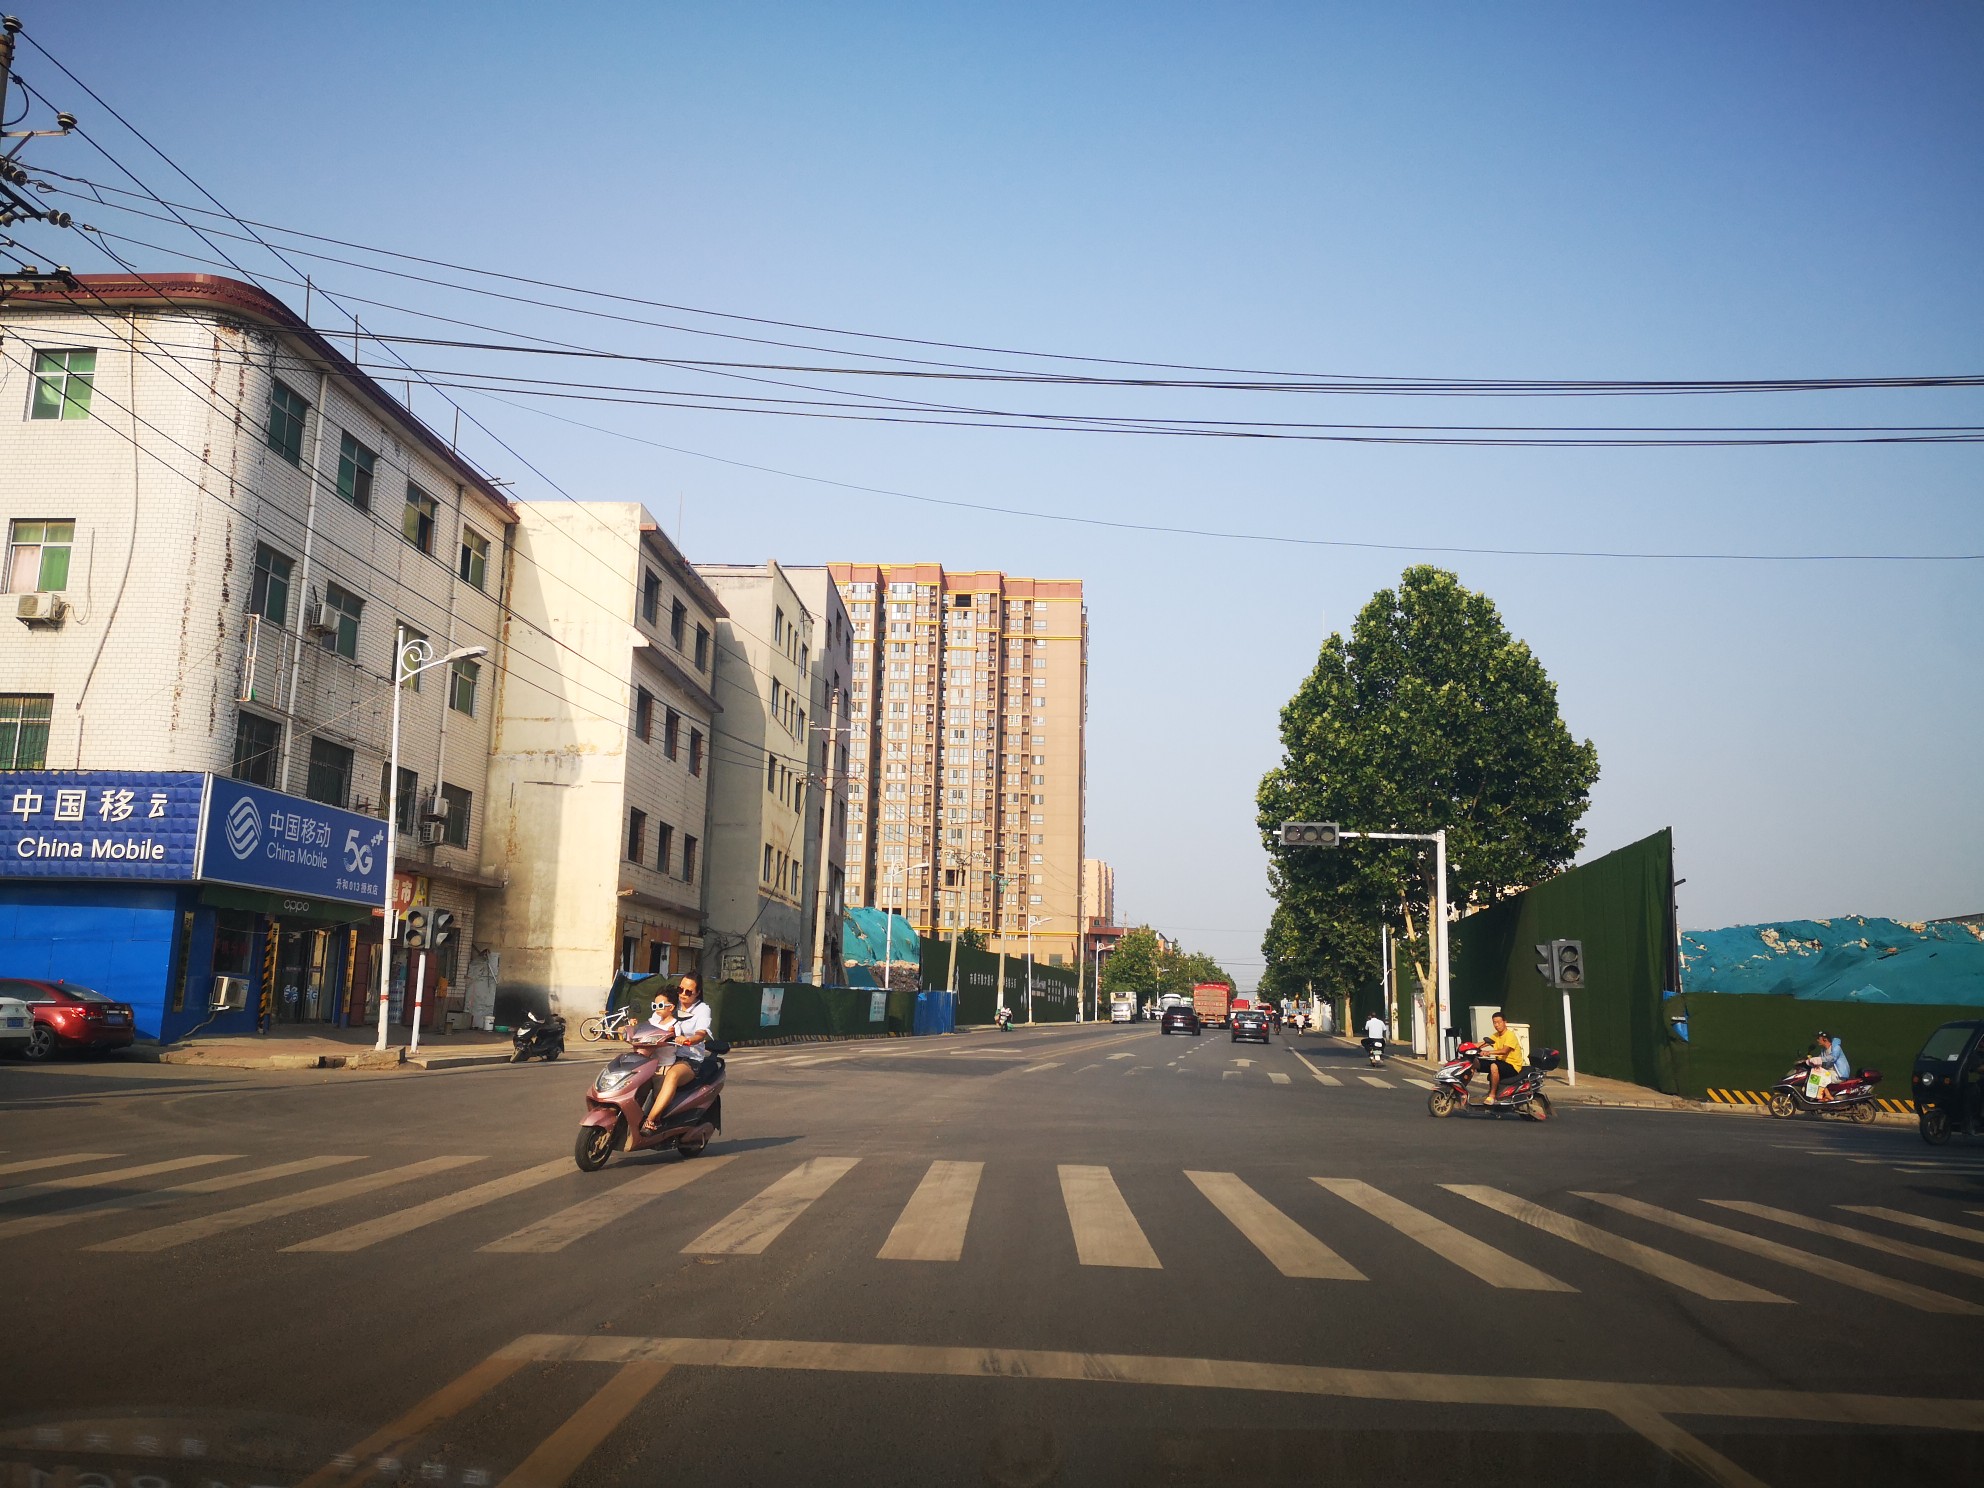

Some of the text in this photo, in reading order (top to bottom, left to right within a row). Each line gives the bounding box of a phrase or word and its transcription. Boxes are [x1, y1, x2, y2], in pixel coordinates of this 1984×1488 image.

[269, 809, 331, 848] 中国移动
[17, 836, 165, 860] China Mobile
[266, 841, 329, 869] China Mobile
